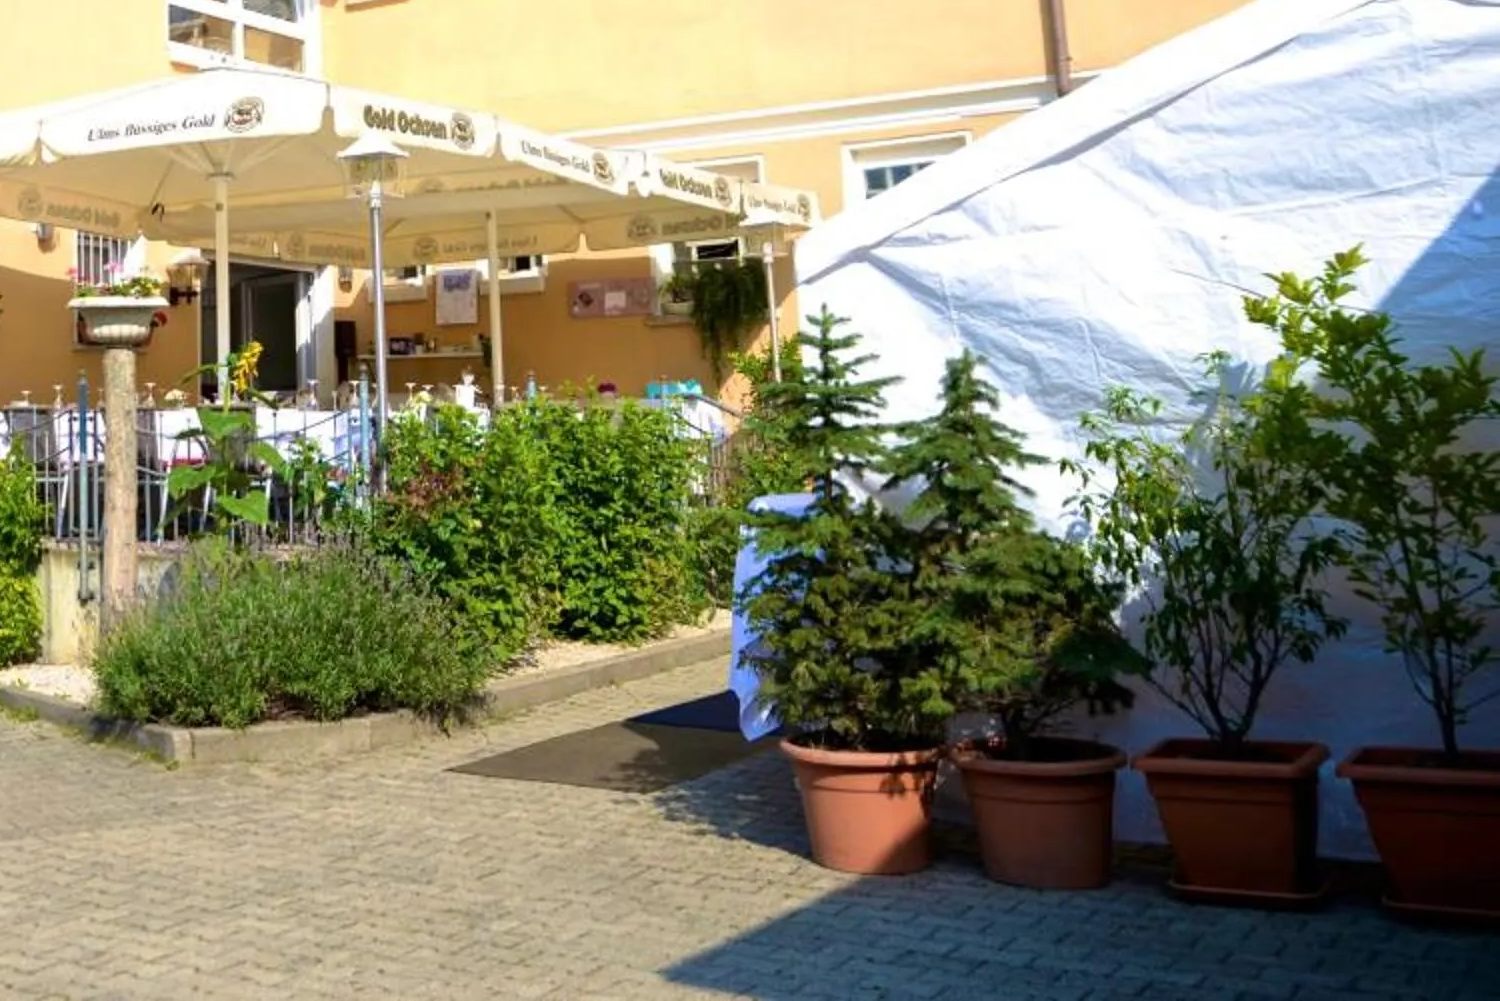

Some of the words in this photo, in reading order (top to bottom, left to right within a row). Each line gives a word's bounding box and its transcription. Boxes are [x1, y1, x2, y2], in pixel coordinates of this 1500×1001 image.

[182, 112, 216, 130] Gold
[363, 104, 395, 133] Gold
[397, 110, 447, 141] Ochsen
